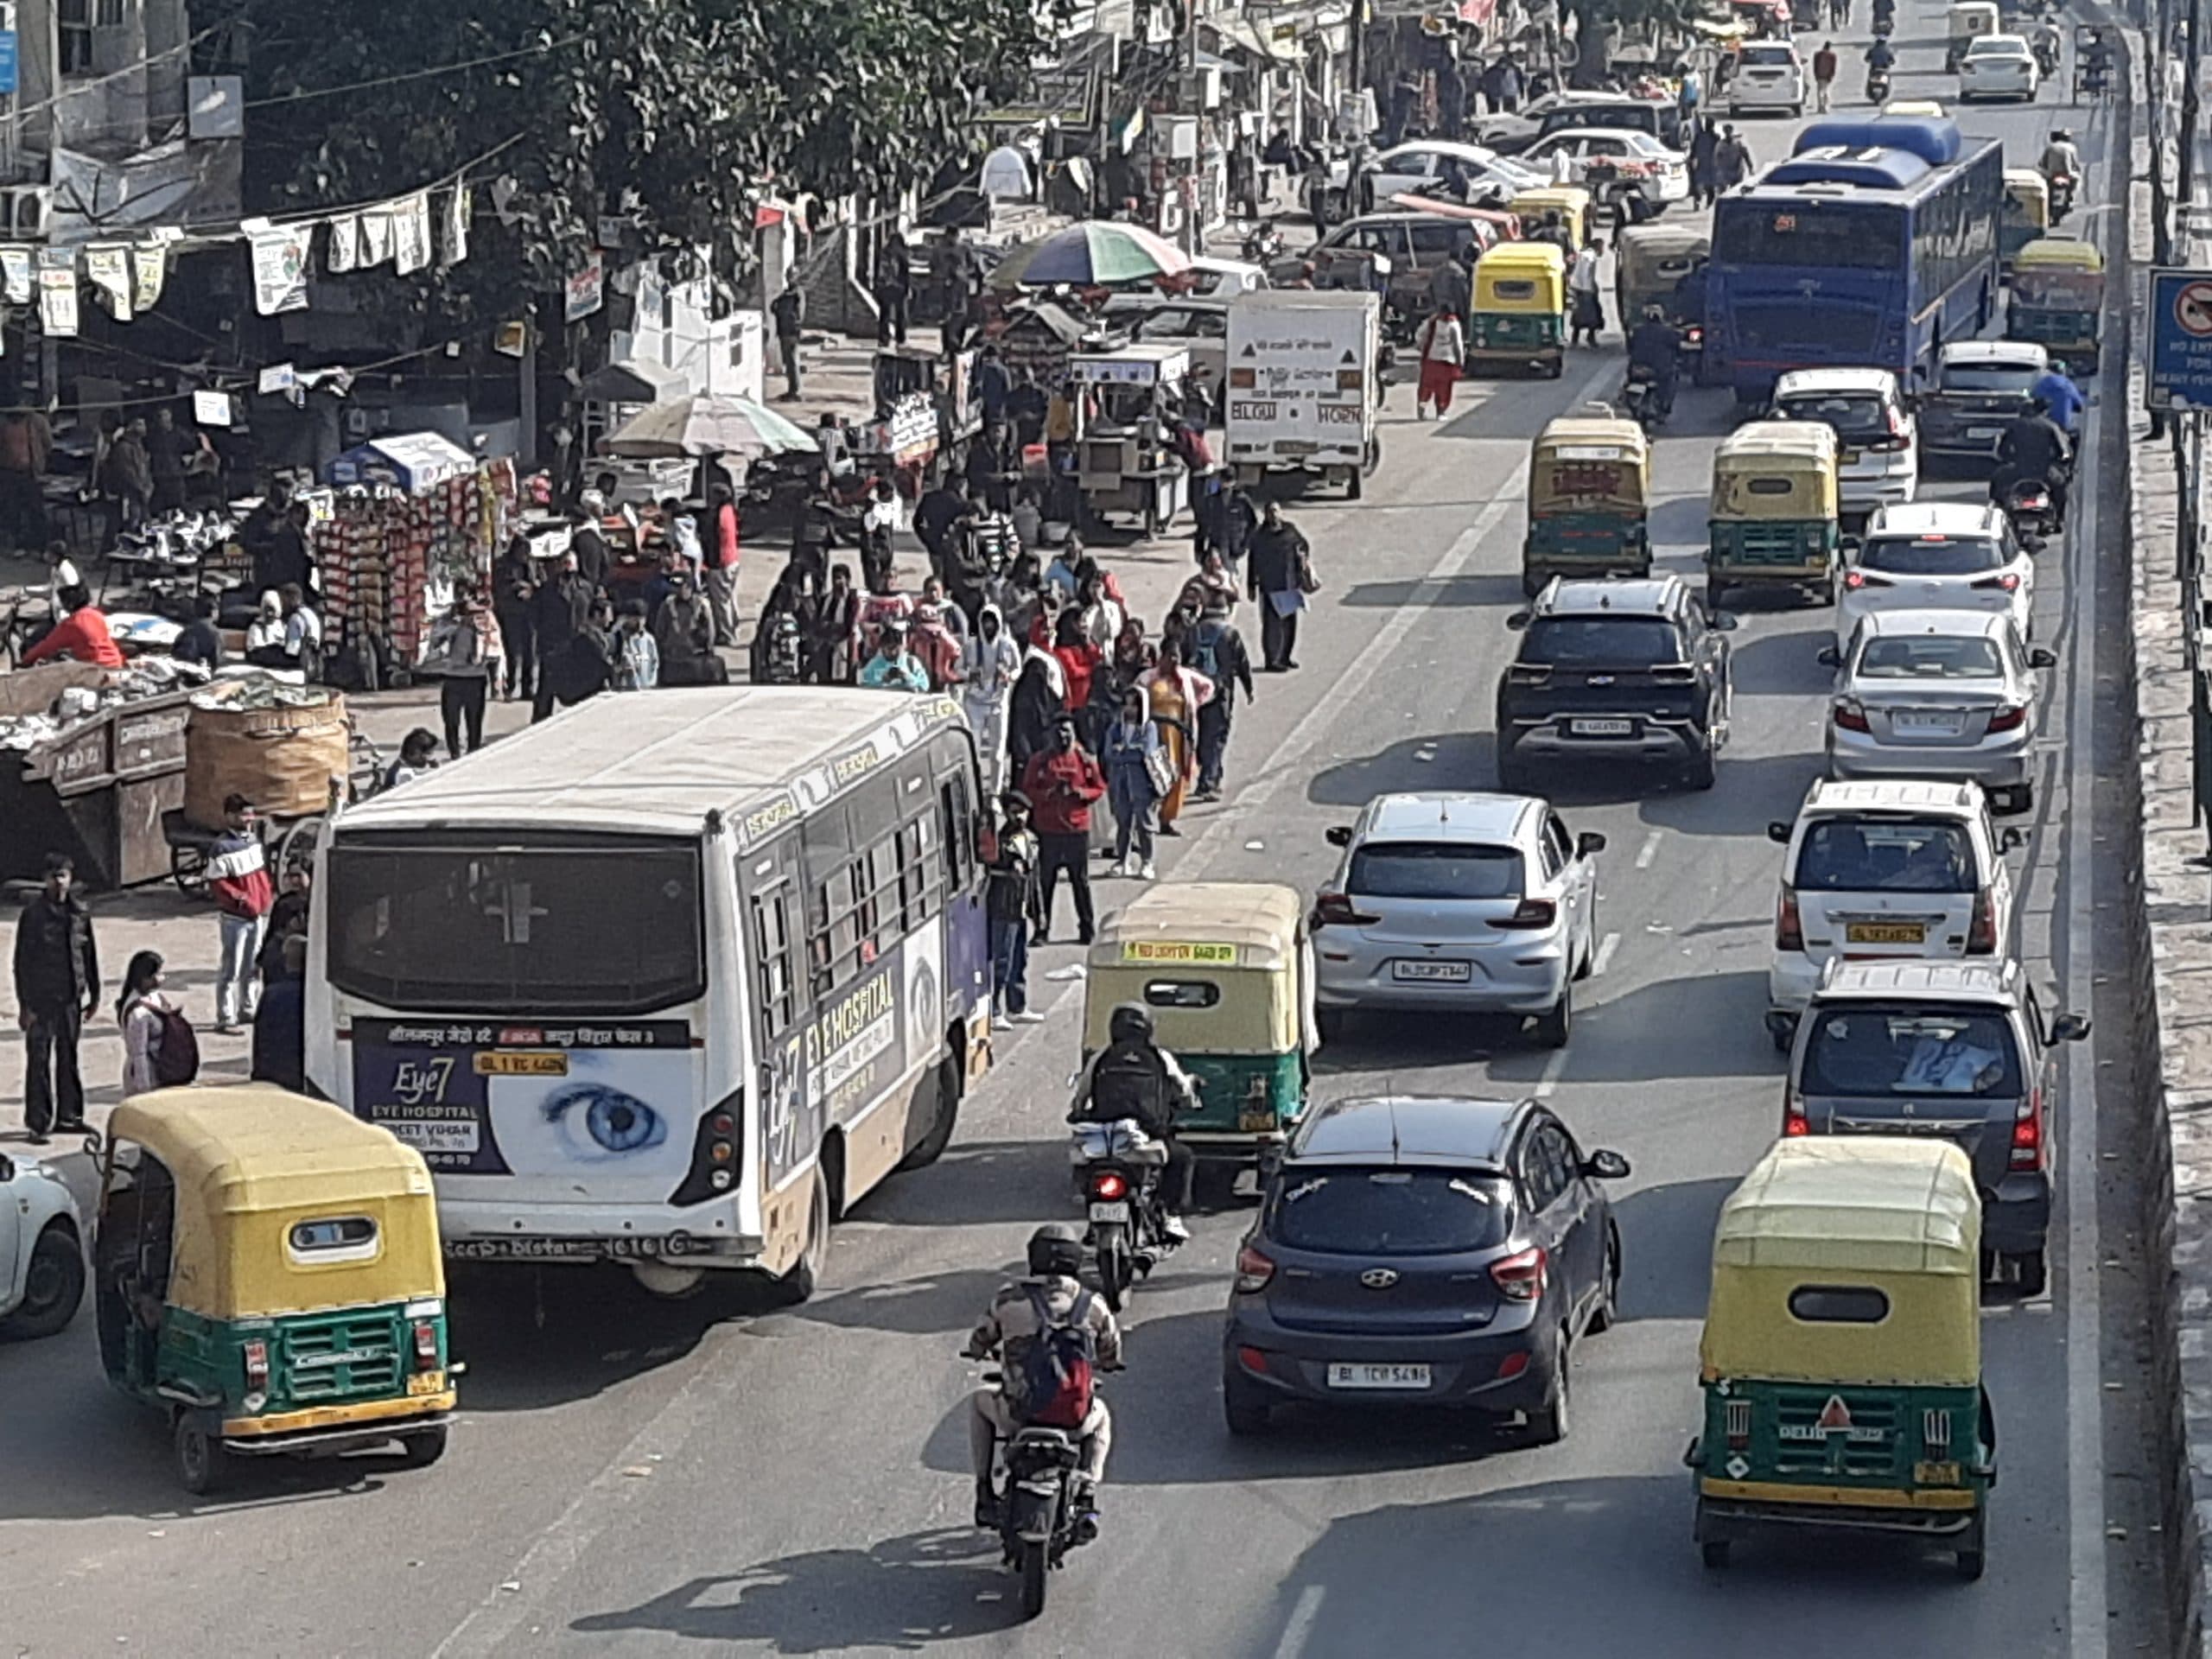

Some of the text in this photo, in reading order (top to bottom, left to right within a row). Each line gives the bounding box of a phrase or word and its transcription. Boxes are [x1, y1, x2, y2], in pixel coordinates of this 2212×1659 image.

[2170, 342, 2187, 352] NO
[2155, 372, 2188, 384] HEAVY
[1318, 405, 1362, 423] HORN
[393, 1057, 455, 1104] Eye7
[372, 1105, 478, 1118] EYE HOSPITAL
